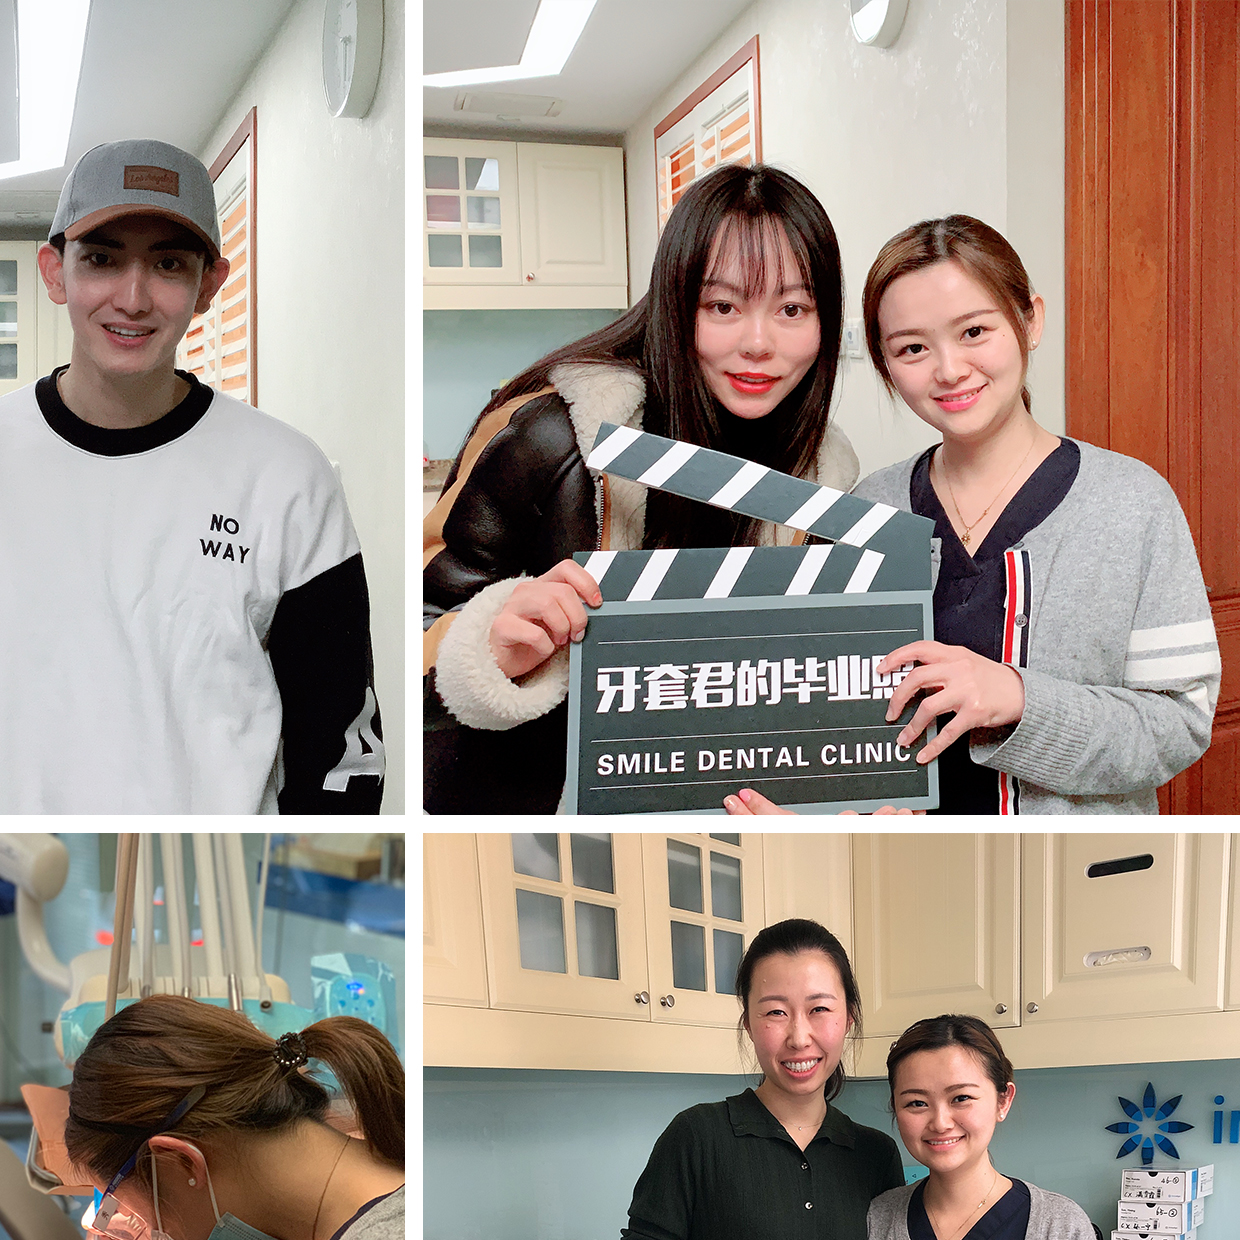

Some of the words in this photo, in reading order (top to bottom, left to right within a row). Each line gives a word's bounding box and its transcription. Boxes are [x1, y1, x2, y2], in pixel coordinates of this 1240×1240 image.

[210, 513, 240, 535] NO
[199, 538, 251, 564] WAY
[596, 751, 686, 776] SMILE
[698, 746, 810, 772] DENTAL
[820, 741, 911, 766] CLINIC
